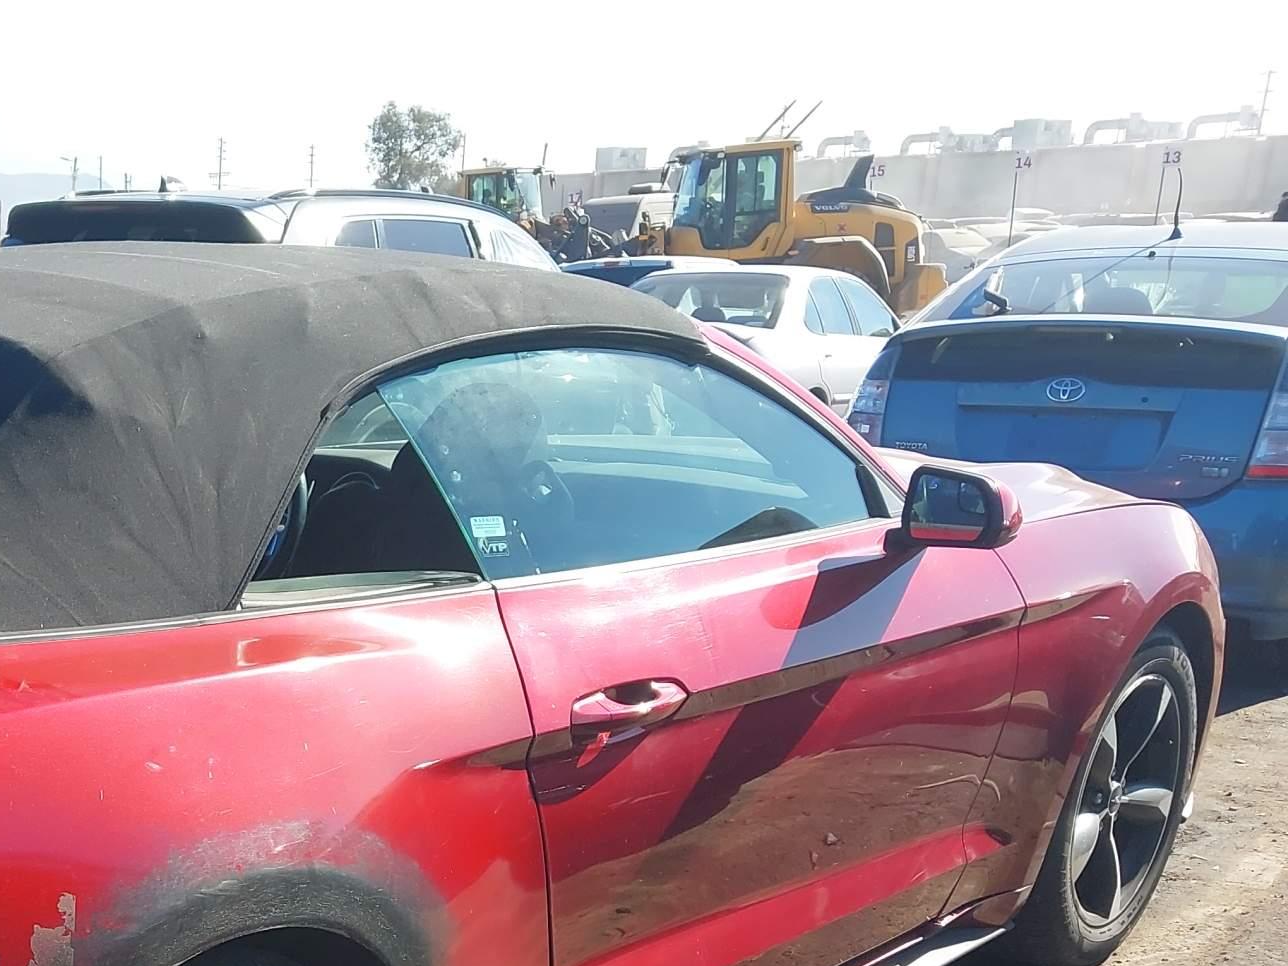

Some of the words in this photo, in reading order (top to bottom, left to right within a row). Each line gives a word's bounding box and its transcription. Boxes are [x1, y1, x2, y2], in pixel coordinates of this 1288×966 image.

[1015, 156, 1033, 169] 14
[1162, 151, 1182, 164] 13
[870, 165, 885, 177] 15
[895, 441, 929, 450] TOYOTA
